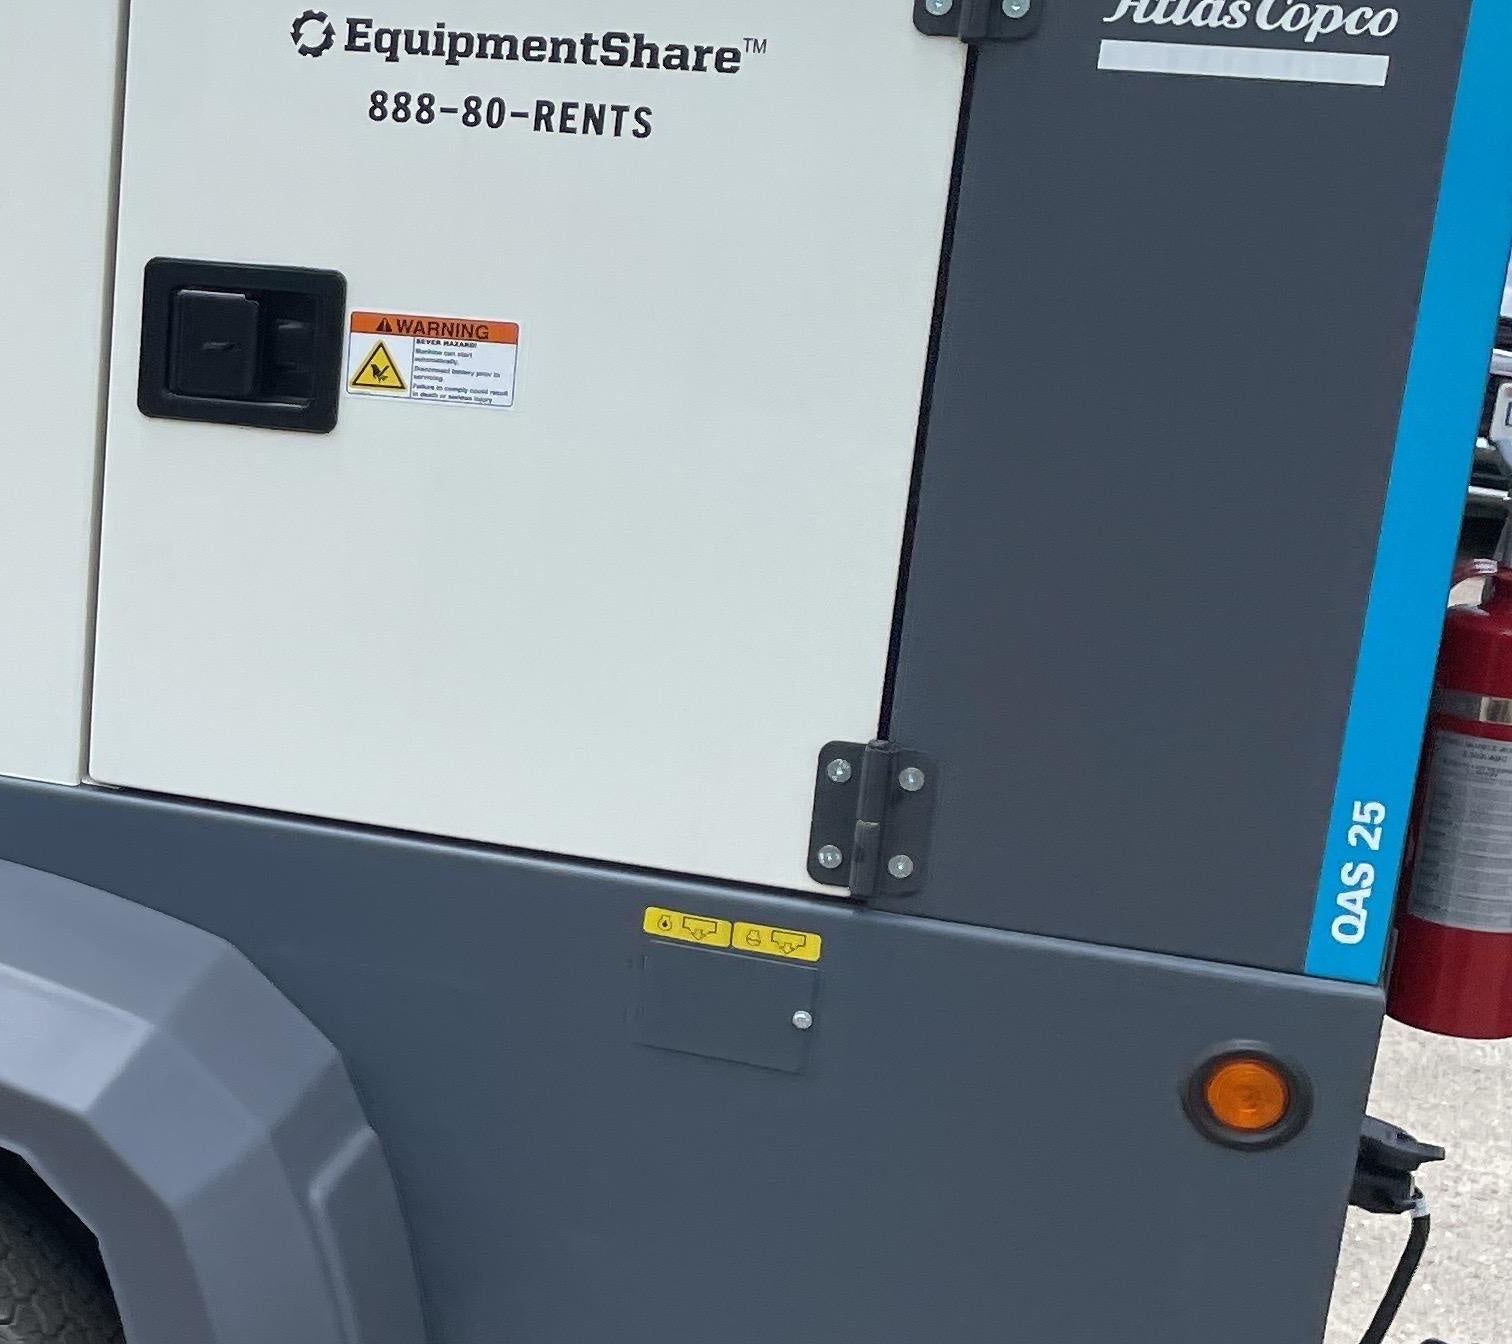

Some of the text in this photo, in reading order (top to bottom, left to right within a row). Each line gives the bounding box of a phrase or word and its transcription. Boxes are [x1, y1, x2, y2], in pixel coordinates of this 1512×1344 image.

[368, 89, 653, 139] 888-80-RENTS
[396, 318, 489, 340] WARNING
[1331, 801, 1386, 944] QAS 25
